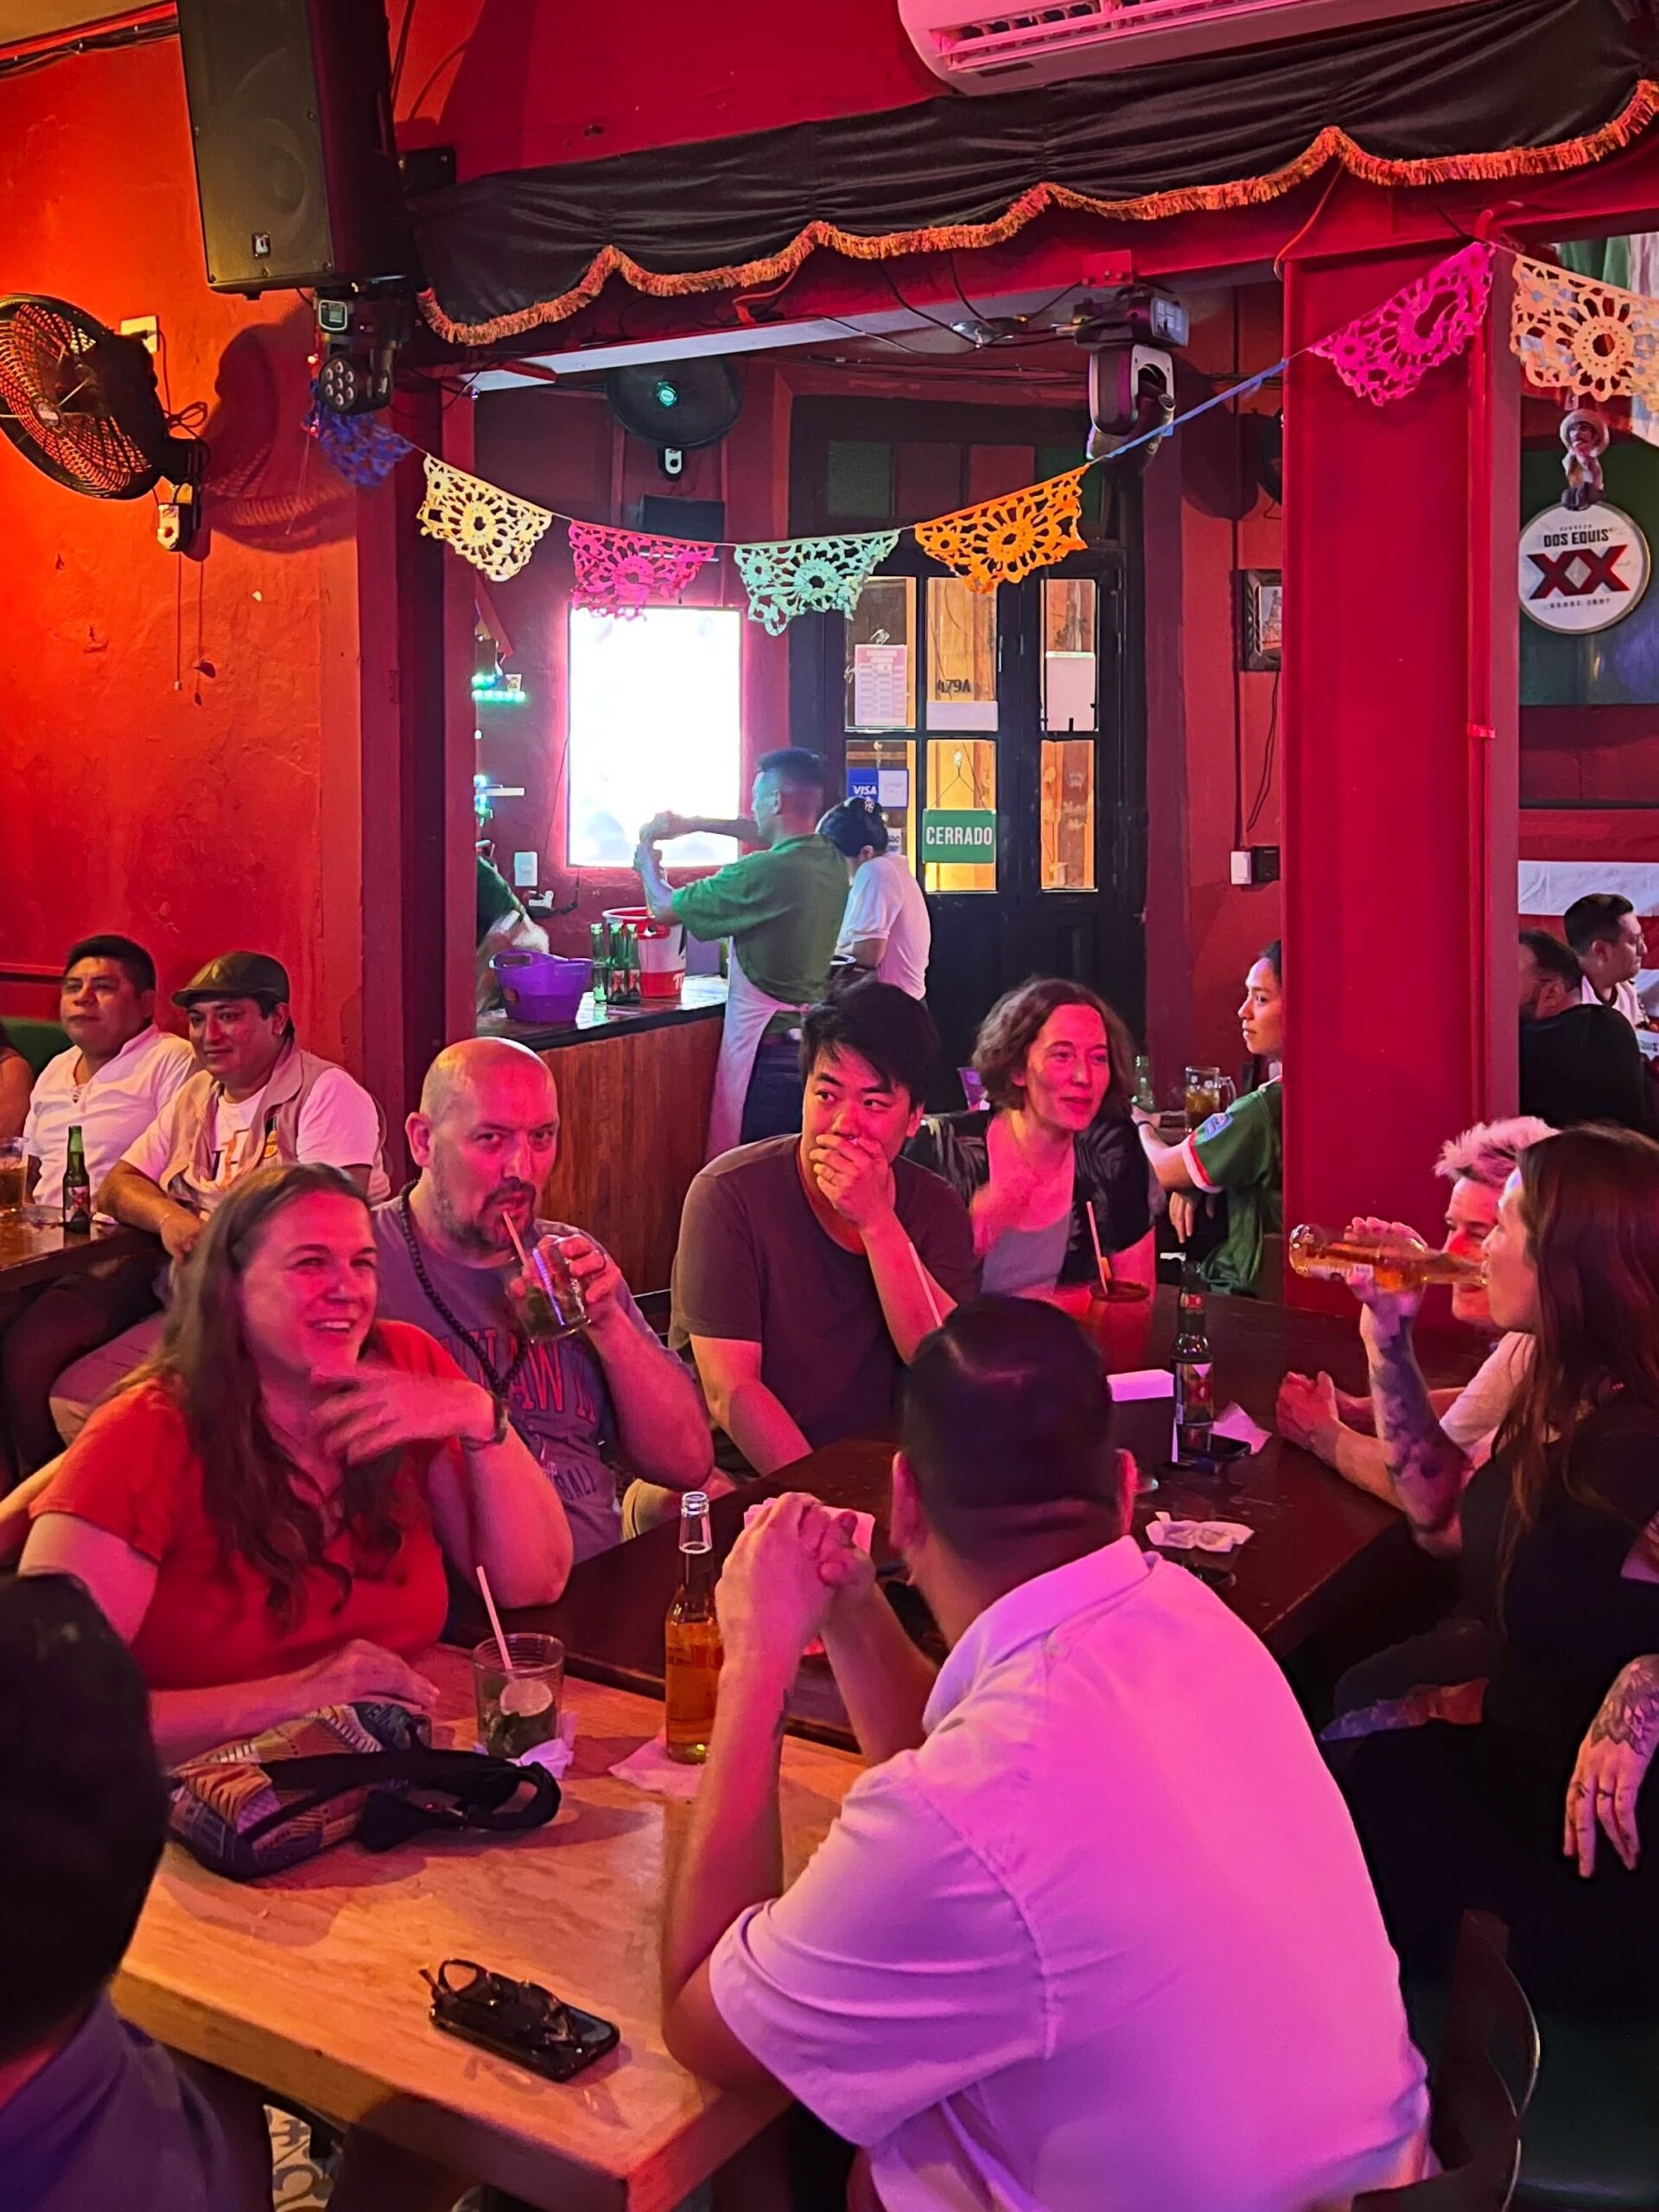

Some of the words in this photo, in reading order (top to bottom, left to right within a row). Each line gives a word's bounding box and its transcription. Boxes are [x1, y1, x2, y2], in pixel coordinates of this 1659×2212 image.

[1543, 533, 1568, 547] DOS
[1572, 529, 1609, 544] EQUIS
[1526, 544, 1630, 600] XX
[852, 785, 878, 796] VISA
[926, 826, 993, 845] CERRADO
